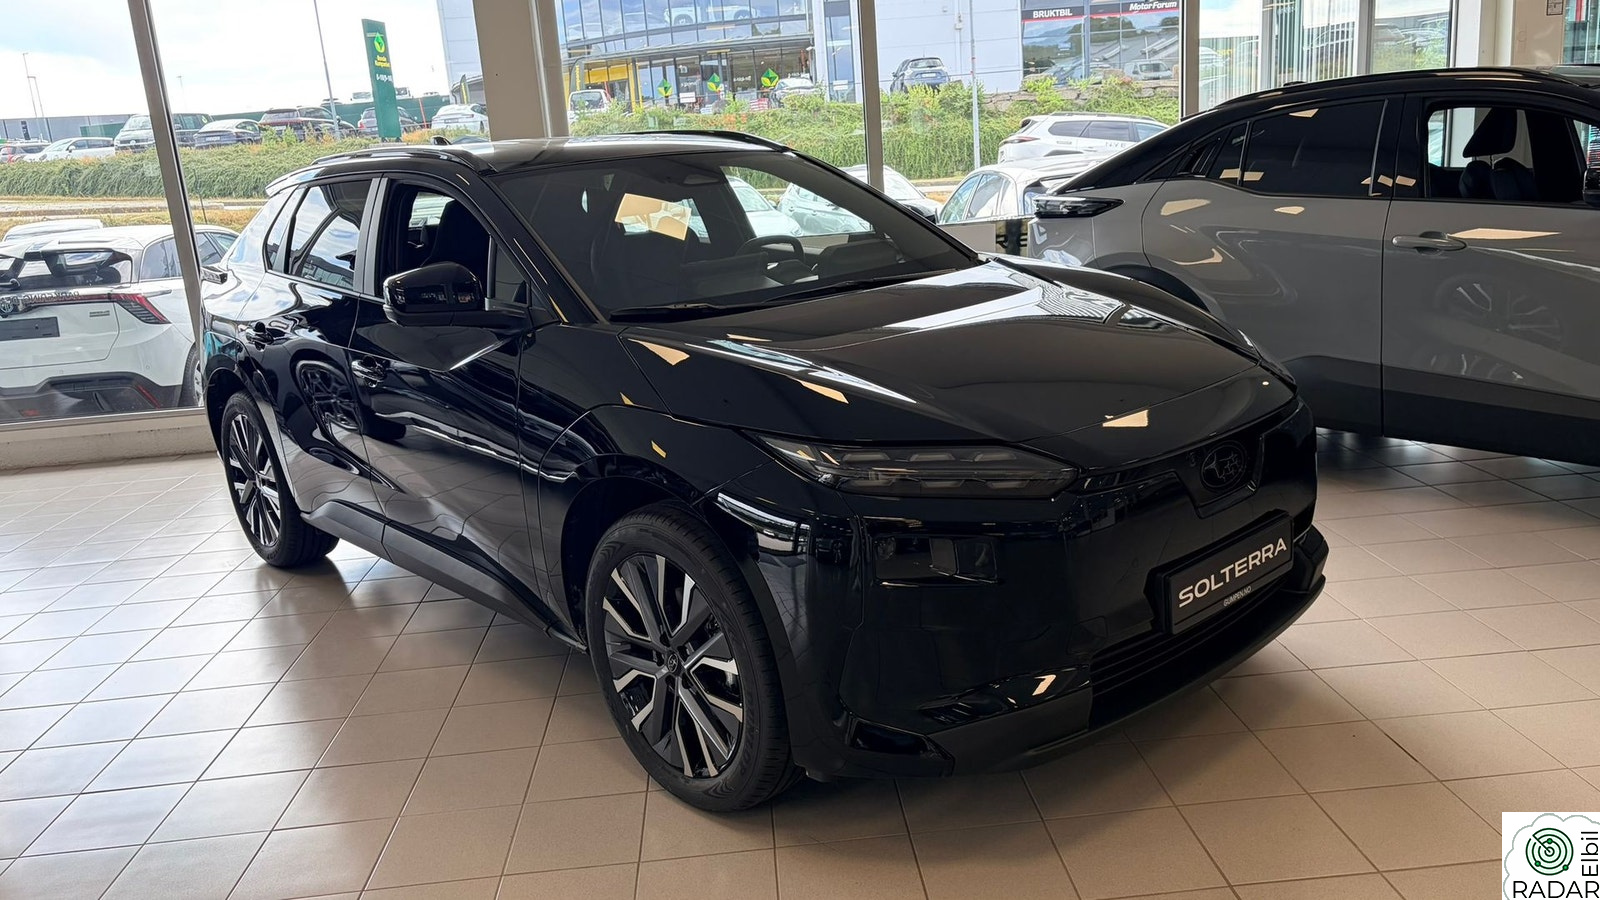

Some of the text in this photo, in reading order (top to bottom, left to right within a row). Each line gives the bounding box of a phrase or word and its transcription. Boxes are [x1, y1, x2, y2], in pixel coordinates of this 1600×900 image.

[1032, 8, 1073, 19] BRUKTBIL
[1178, 537, 1288, 608] SOLTERRA
[1223, 586, 1252, 607] GUMPEN.NO
